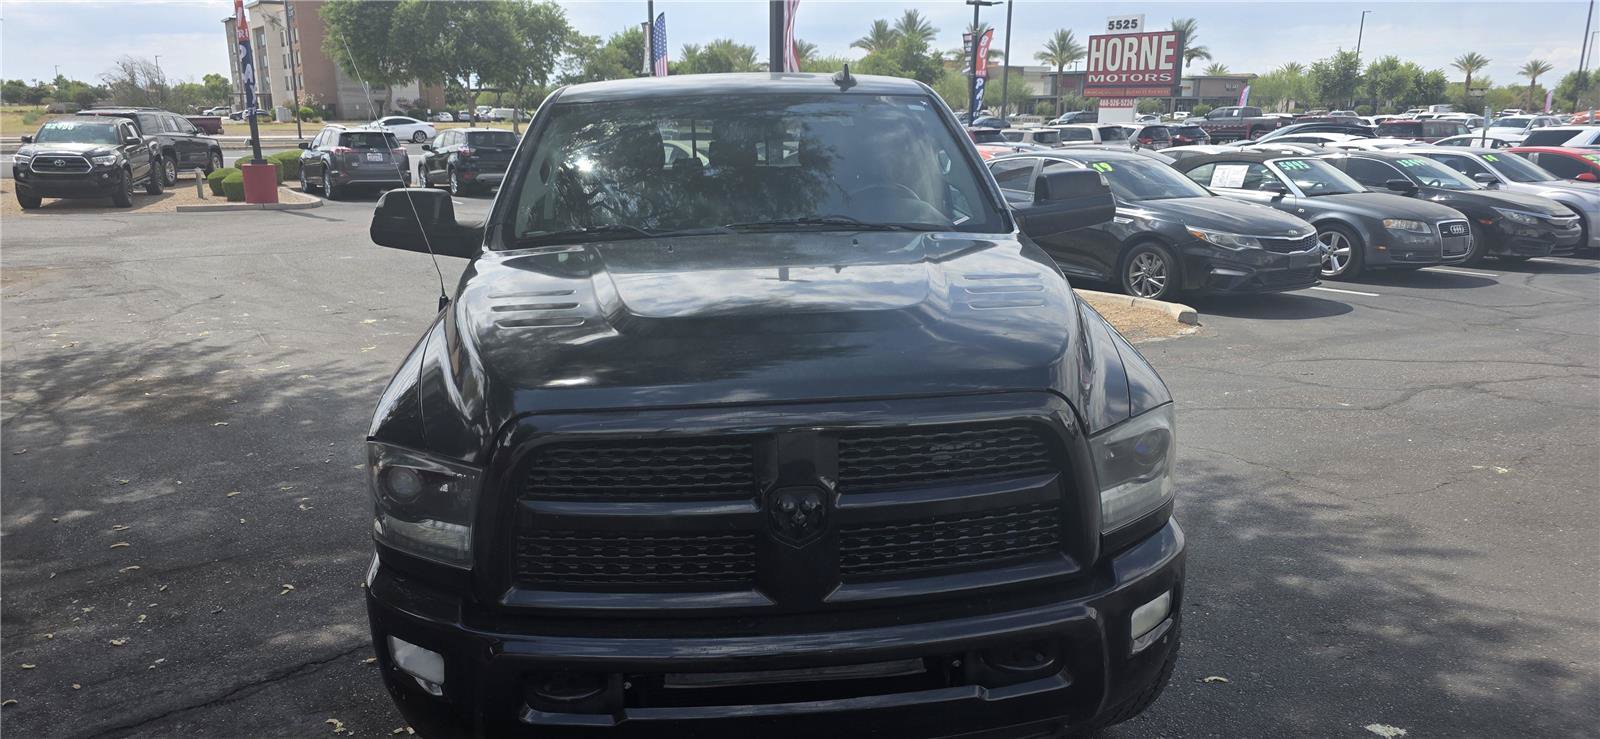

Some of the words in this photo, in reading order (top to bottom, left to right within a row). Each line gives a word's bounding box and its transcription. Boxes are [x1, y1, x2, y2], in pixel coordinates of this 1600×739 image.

[1108, 18, 1138, 30] 5525
[1089, 34, 1176, 72] HORNE
[1088, 73, 1172, 83] MOTORS
[1092, 162, 1113, 173] 19
[1278, 160, 1310, 170] 5995
